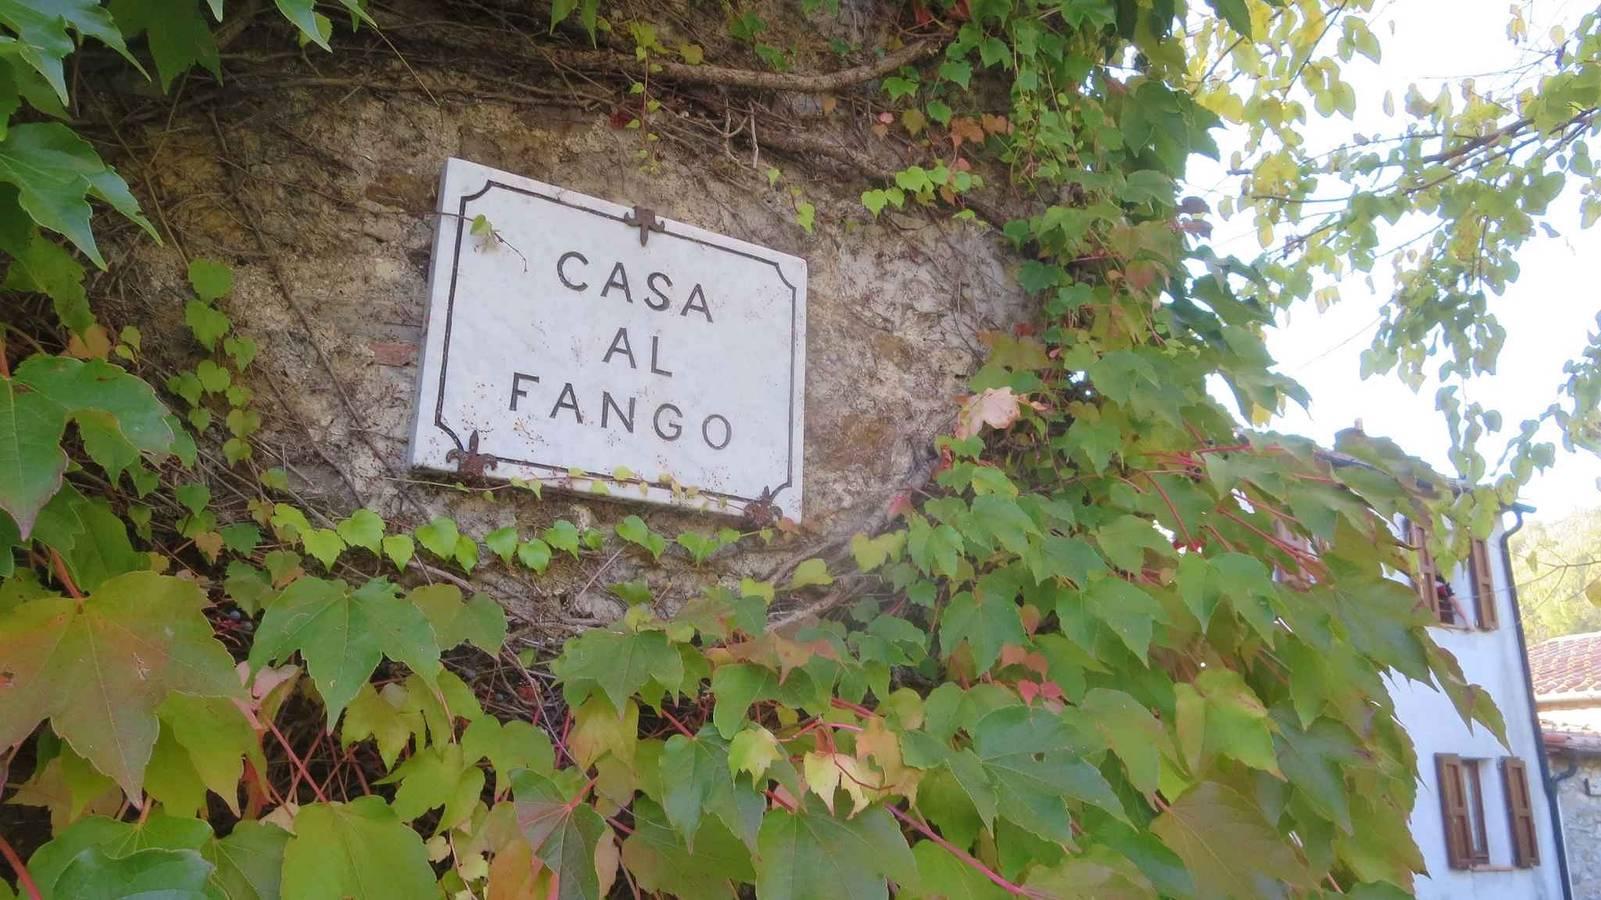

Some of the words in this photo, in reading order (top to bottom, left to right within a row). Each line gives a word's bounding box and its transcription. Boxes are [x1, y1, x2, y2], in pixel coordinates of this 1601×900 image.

[556, 251, 714, 323] CASA
[602, 327, 673, 378] AL
[508, 371, 733, 451] FANGO
